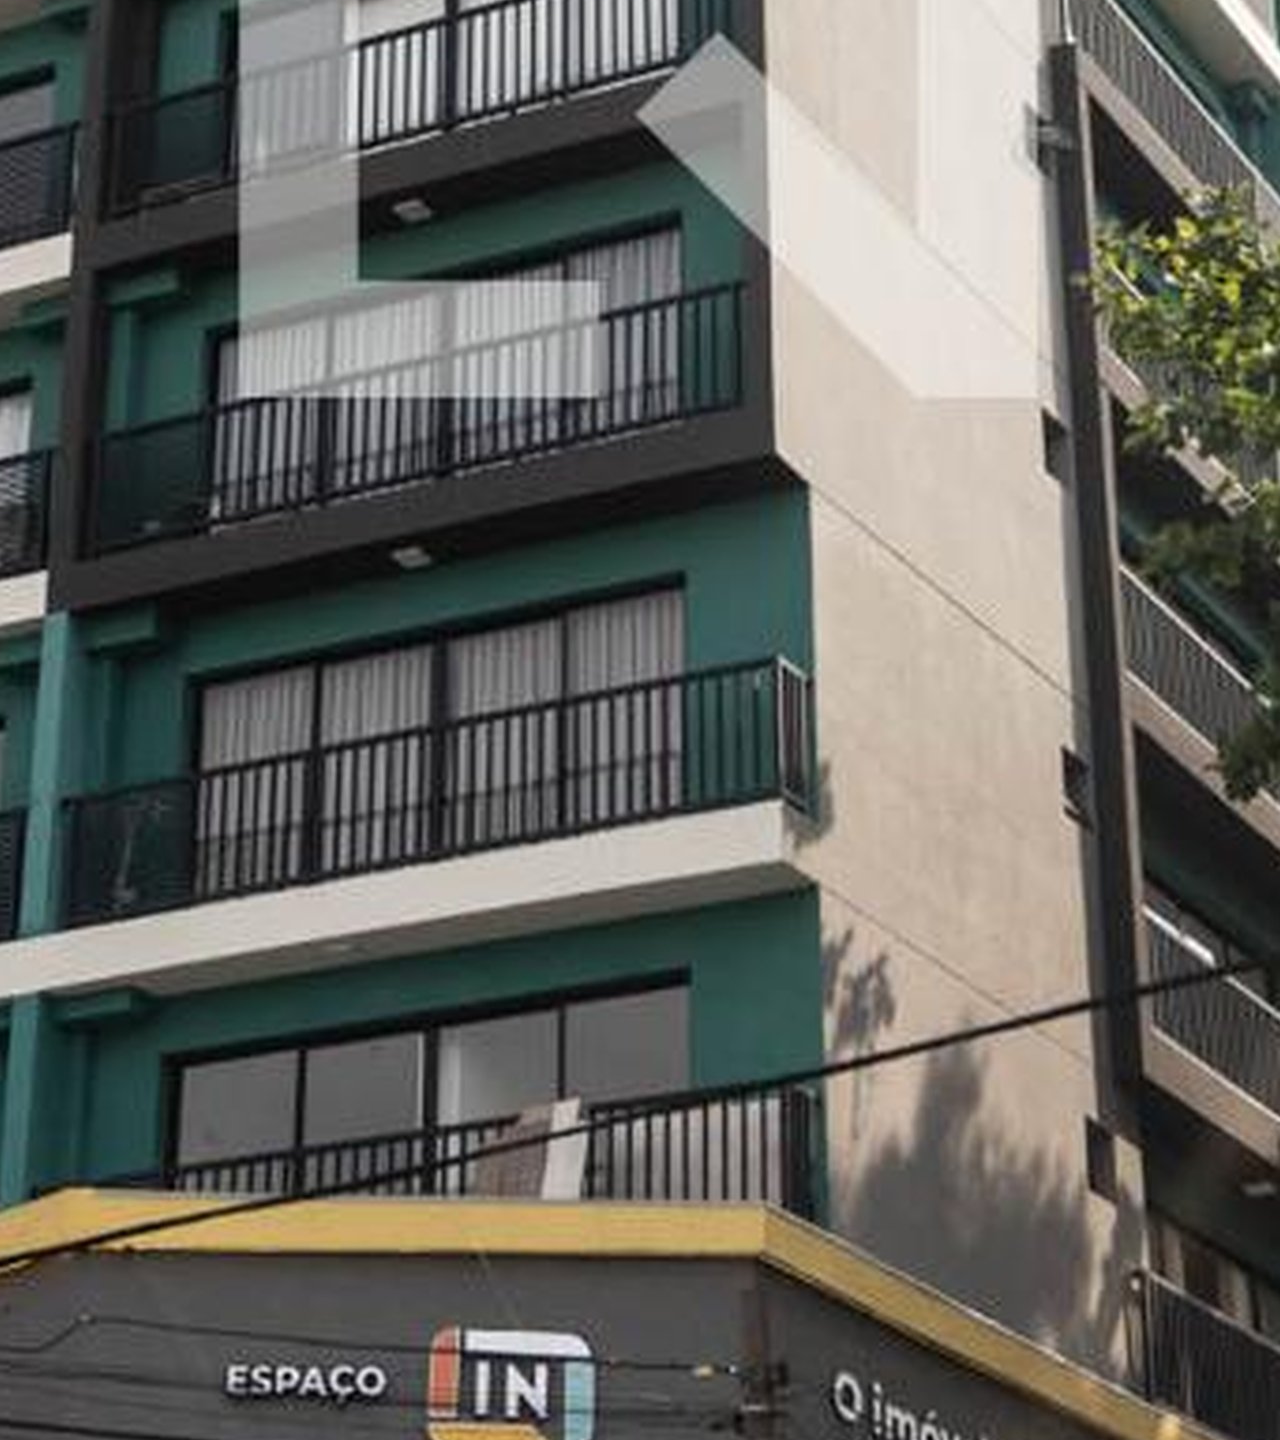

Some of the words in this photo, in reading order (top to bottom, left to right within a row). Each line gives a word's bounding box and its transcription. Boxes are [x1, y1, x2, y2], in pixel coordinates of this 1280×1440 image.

[225, 1364, 387, 1403] ESPAÇO
[474, 1360, 549, 1419] IN
[834, 1372, 863, 1420] O
